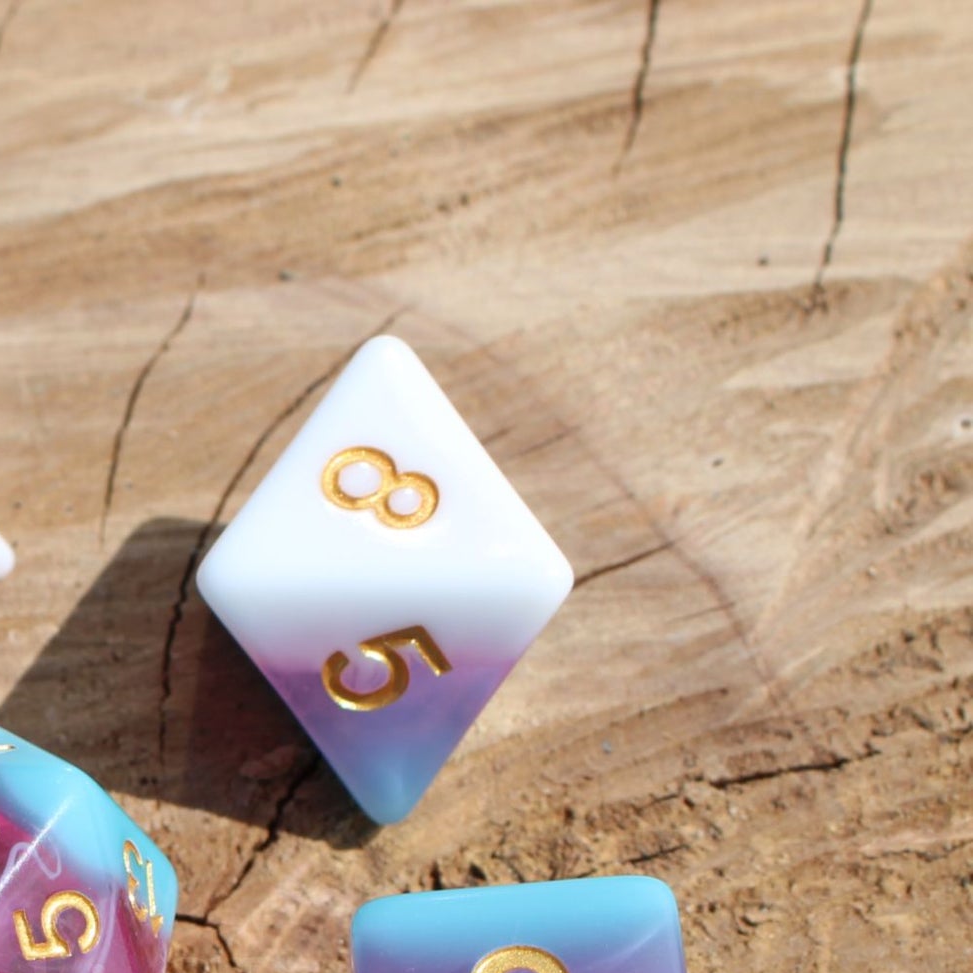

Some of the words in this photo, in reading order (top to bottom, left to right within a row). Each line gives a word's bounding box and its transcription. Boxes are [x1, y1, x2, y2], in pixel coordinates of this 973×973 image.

[321, 445, 439, 530] 8
[321, 624, 453, 711] 5
[12, 889, 101, 961] 5
